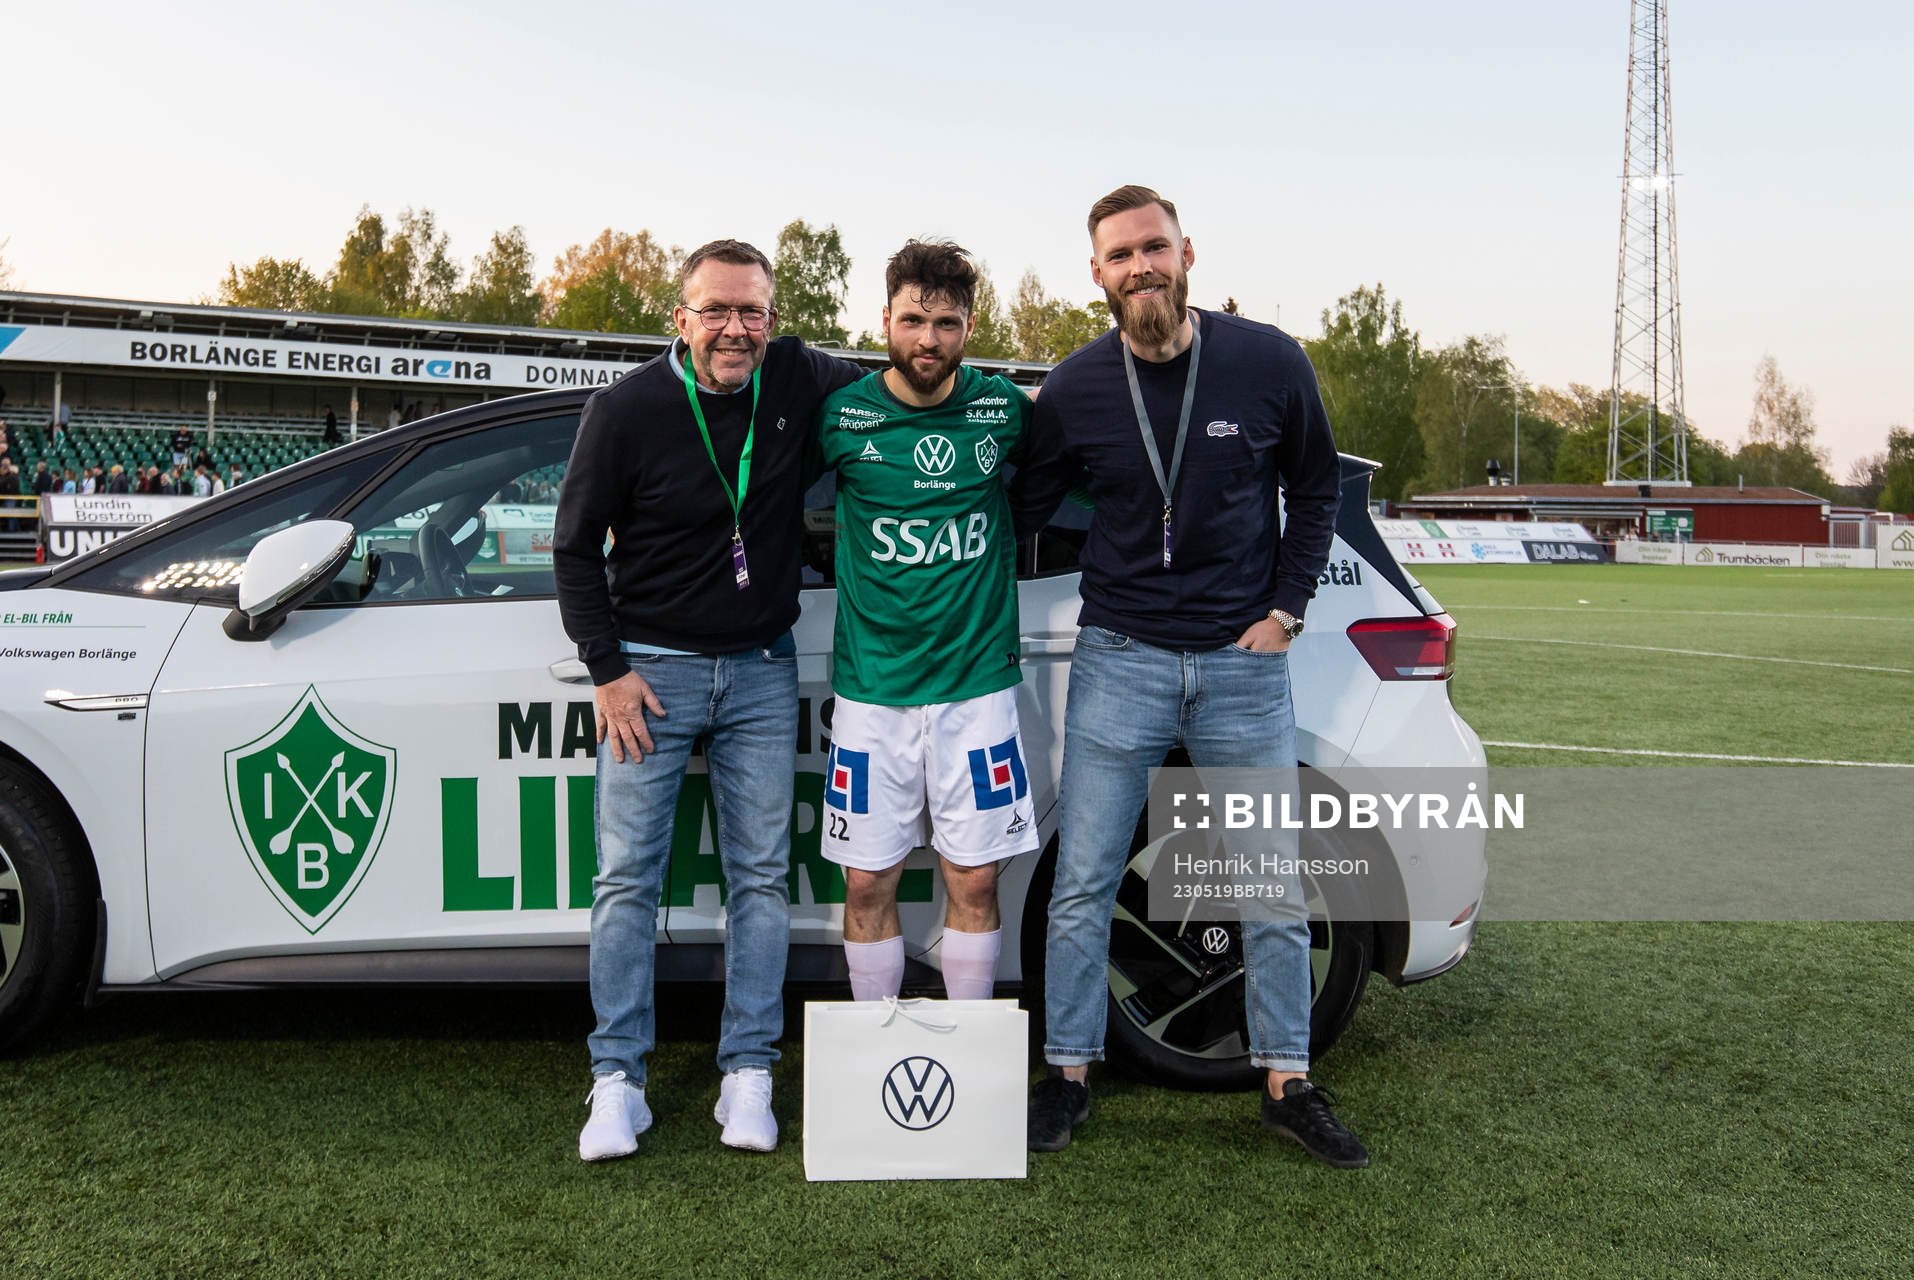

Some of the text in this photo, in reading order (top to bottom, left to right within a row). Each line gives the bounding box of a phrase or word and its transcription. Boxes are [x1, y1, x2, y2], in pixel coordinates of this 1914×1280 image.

[130, 341, 491, 381] BORLÄNGE ENERGI arena
[840, 406, 887, 422] HARSCO
[966, 409, 1009, 419] S.K.M.A.
[913, 480, 956, 490] Borlänge
[75, 498, 131, 510] Lundin
[75, 510, 153, 522] Boström
[870, 511, 988, 565] SSAB
[1717, 553, 1790, 566] Trumbäcken
[4, 613, 38, 624] EL-BIL
[42, 611, 73, 624] FRÅN
[78, 648, 137, 661] Borlänge
[829, 812, 850, 841] 22
[1006, 823, 1028, 836] SELECT
